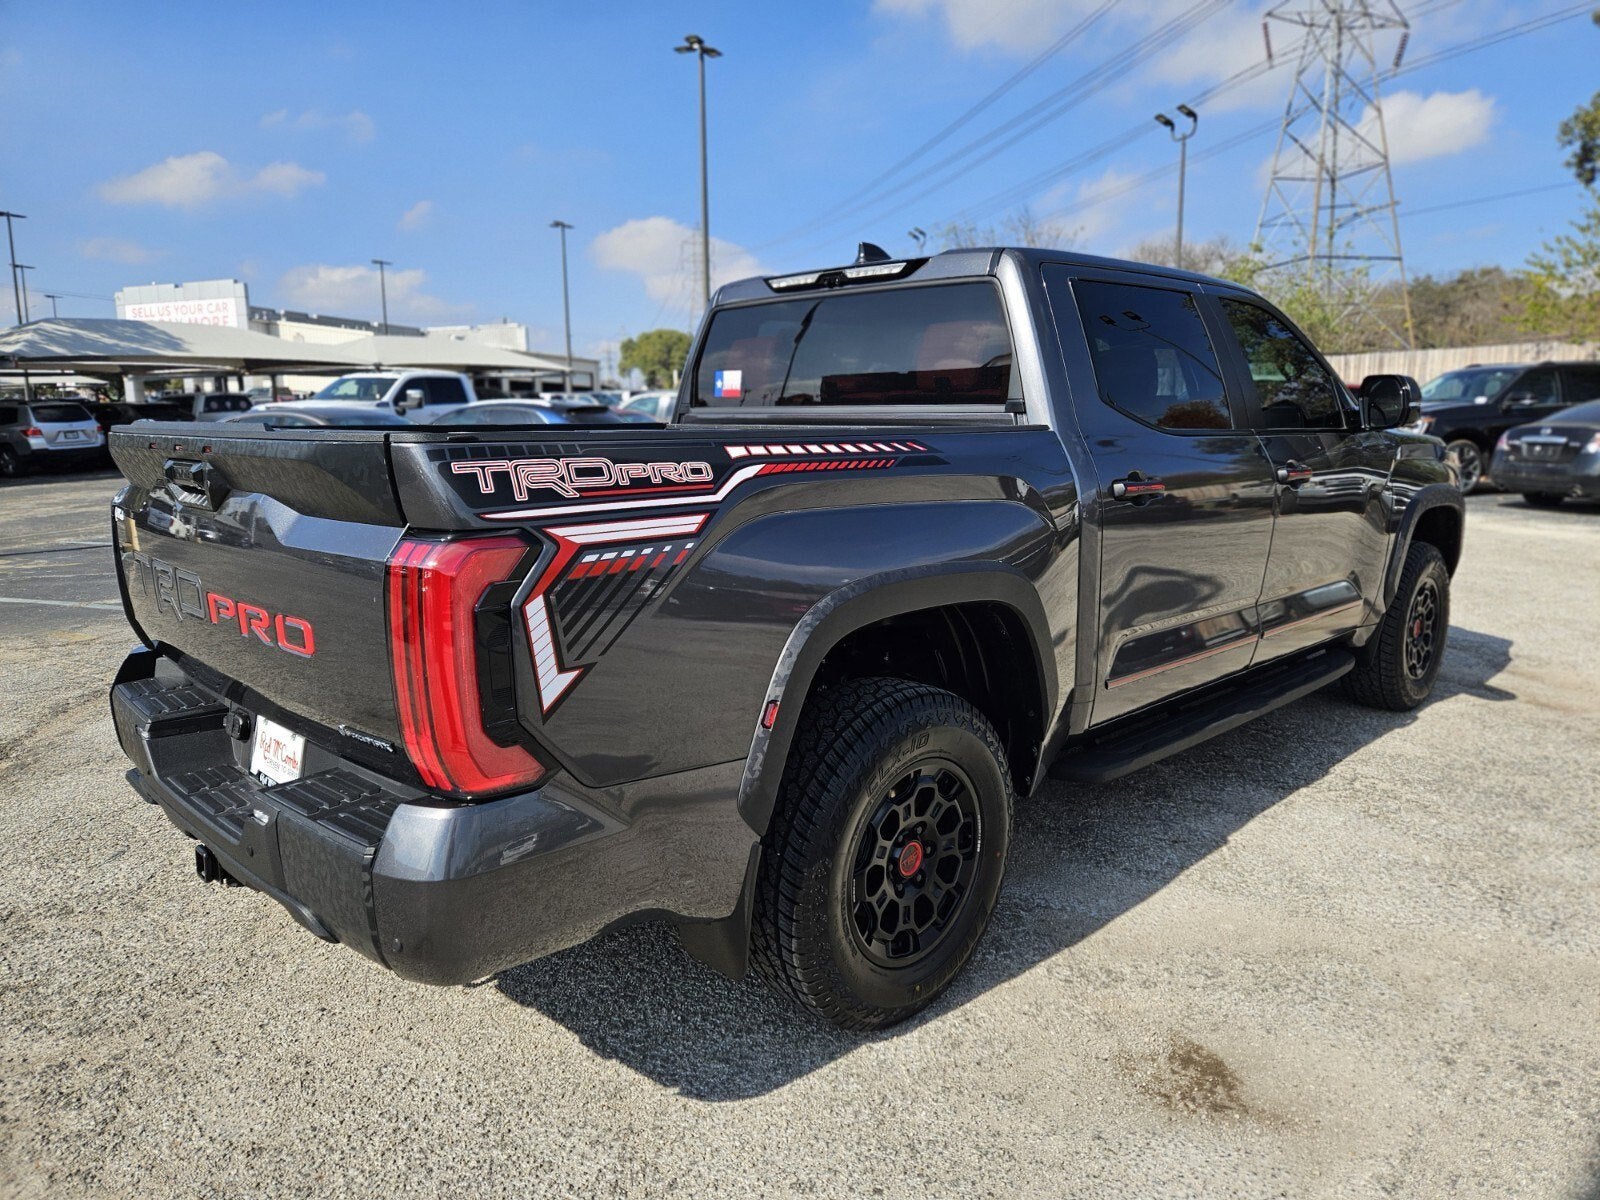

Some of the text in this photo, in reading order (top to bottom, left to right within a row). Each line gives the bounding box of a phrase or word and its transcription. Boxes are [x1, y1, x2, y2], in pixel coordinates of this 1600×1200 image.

[132, 302, 229, 318] SELL US YOUR CAR
[206, 591, 316, 659] PRO
